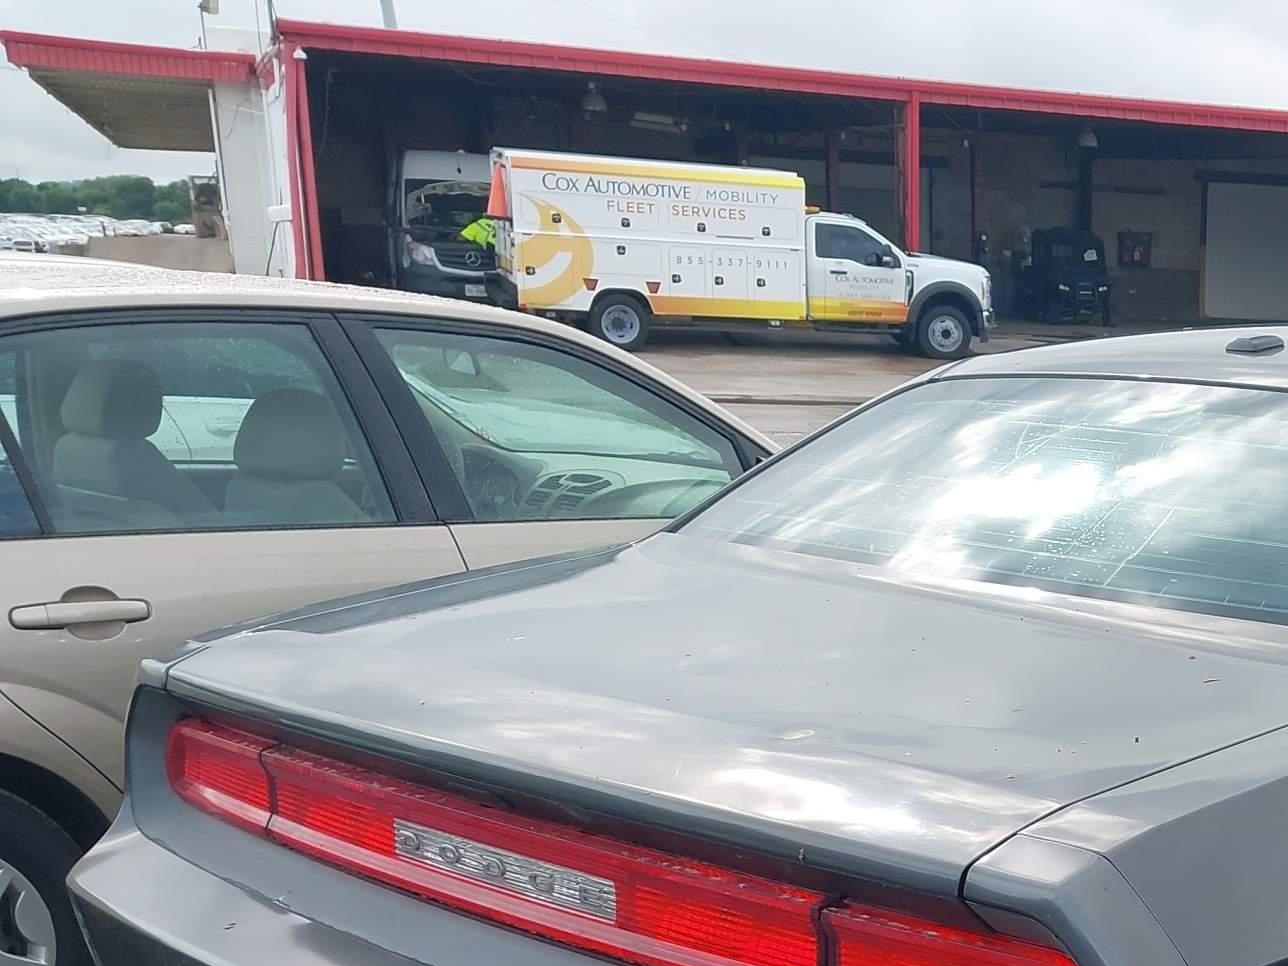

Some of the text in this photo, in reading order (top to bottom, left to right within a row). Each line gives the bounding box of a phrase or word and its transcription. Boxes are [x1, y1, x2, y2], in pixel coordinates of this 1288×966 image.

[542, 172, 580, 193] COX
[584, 176, 691, 200] AUTOMOTIVE
[706, 190, 780, 205] MOBILITY
[606, 200, 747, 222] FLEET SERVICES
[397, 829, 614, 905] DODGE
